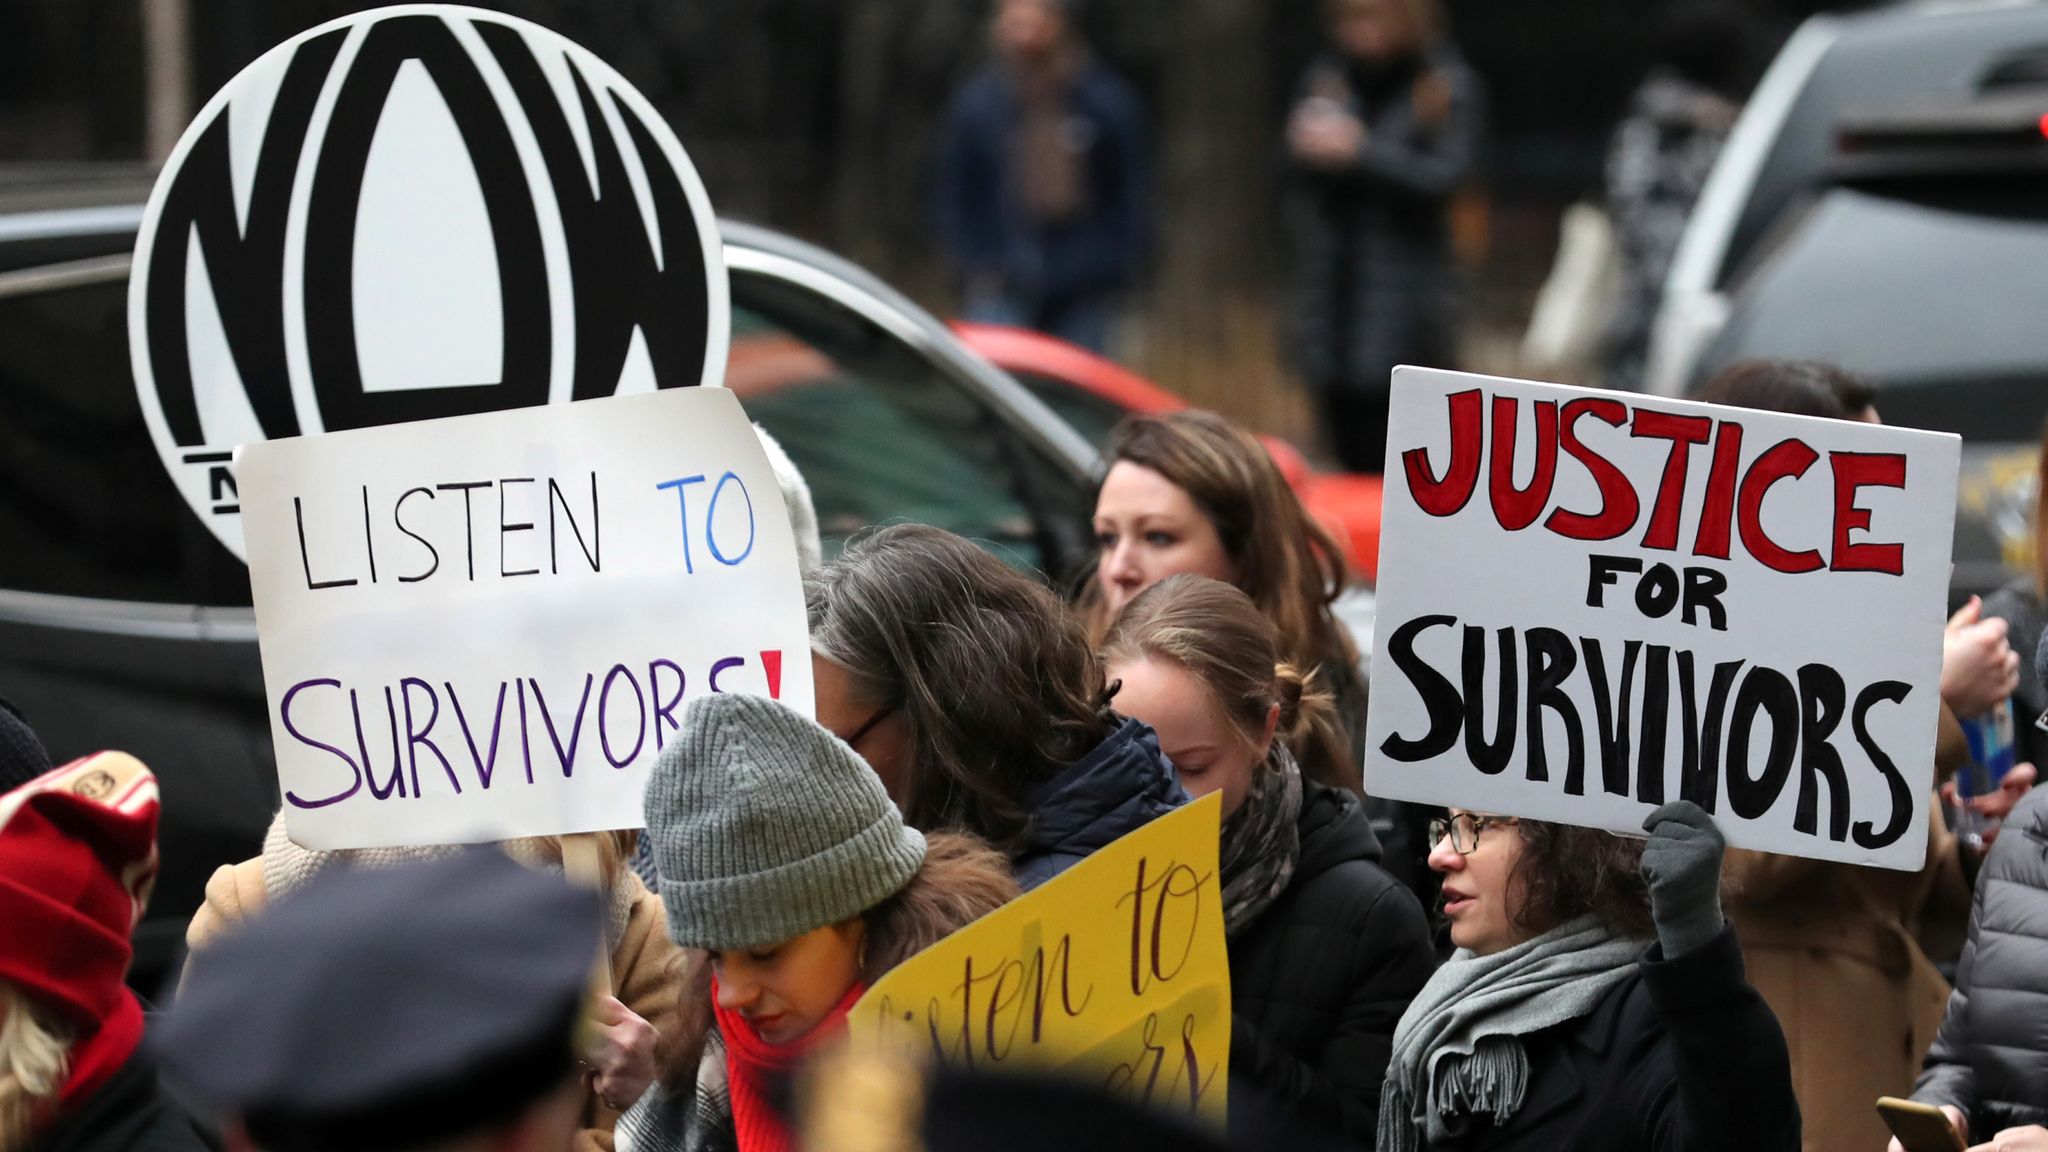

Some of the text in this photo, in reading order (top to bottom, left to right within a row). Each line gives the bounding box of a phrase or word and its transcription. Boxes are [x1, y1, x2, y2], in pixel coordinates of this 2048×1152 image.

[146, 15, 709, 447] NOW
[293, 471, 754, 589] LISTEN TO
[1402, 388, 1907, 576] JUSTICE
[1586, 554, 1728, 631] FOR
[1379, 614, 1913, 850] SURVIVORS
[1115, 857, 1212, 996] to
